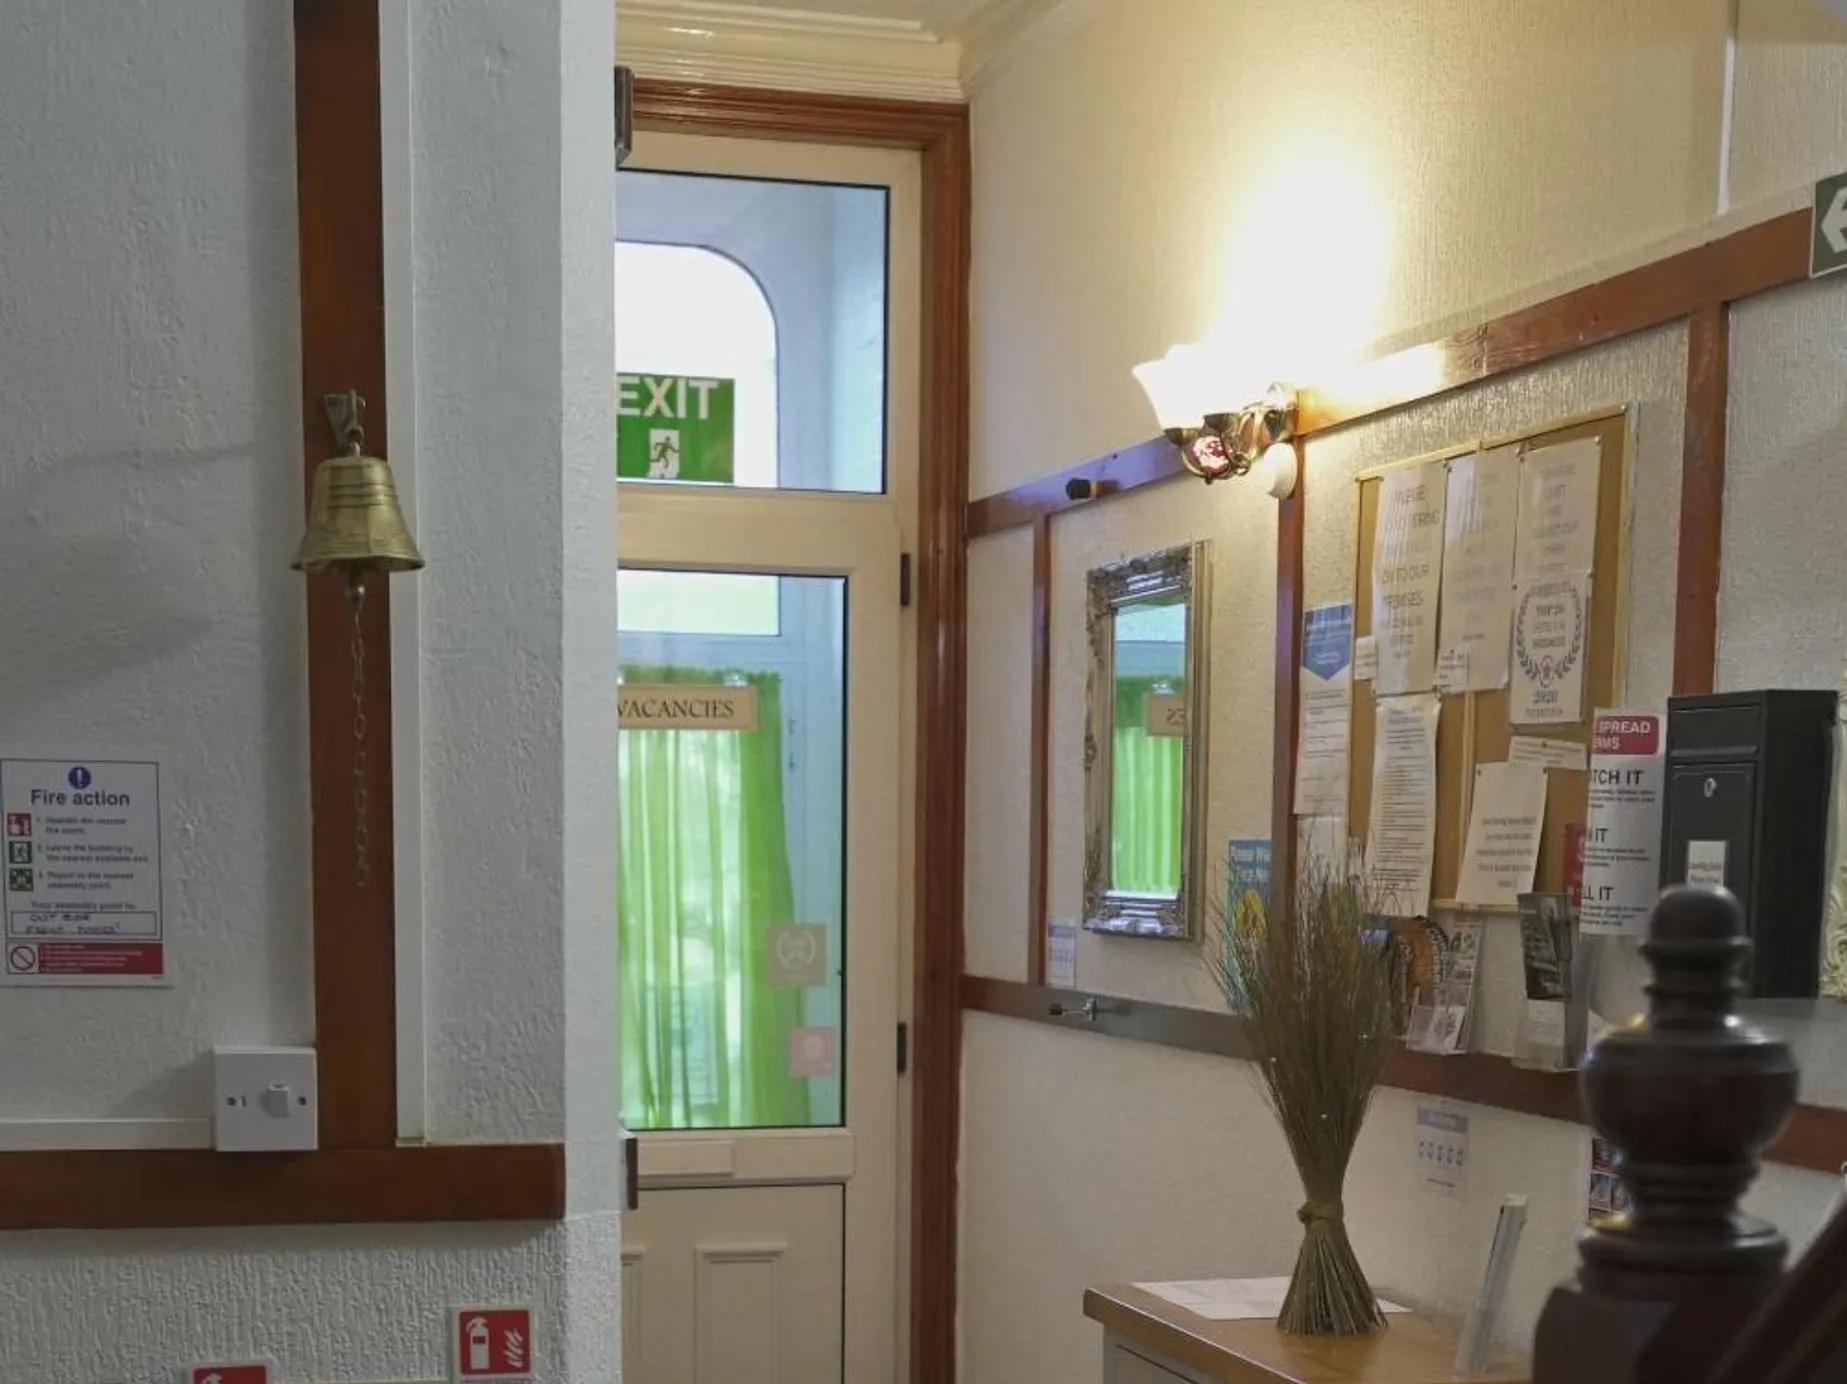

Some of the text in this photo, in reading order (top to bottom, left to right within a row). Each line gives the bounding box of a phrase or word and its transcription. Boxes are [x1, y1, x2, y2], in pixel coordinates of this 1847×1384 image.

[616, 375, 720, 420] EXIT
[617, 699, 735, 718] VACANCIES
[1592, 768, 1645, 785] TCH IT
[29, 788, 131, 807] Fire action
[1595, 828, 1610, 842] IT
[1599, 886, 1616, 901] IT
